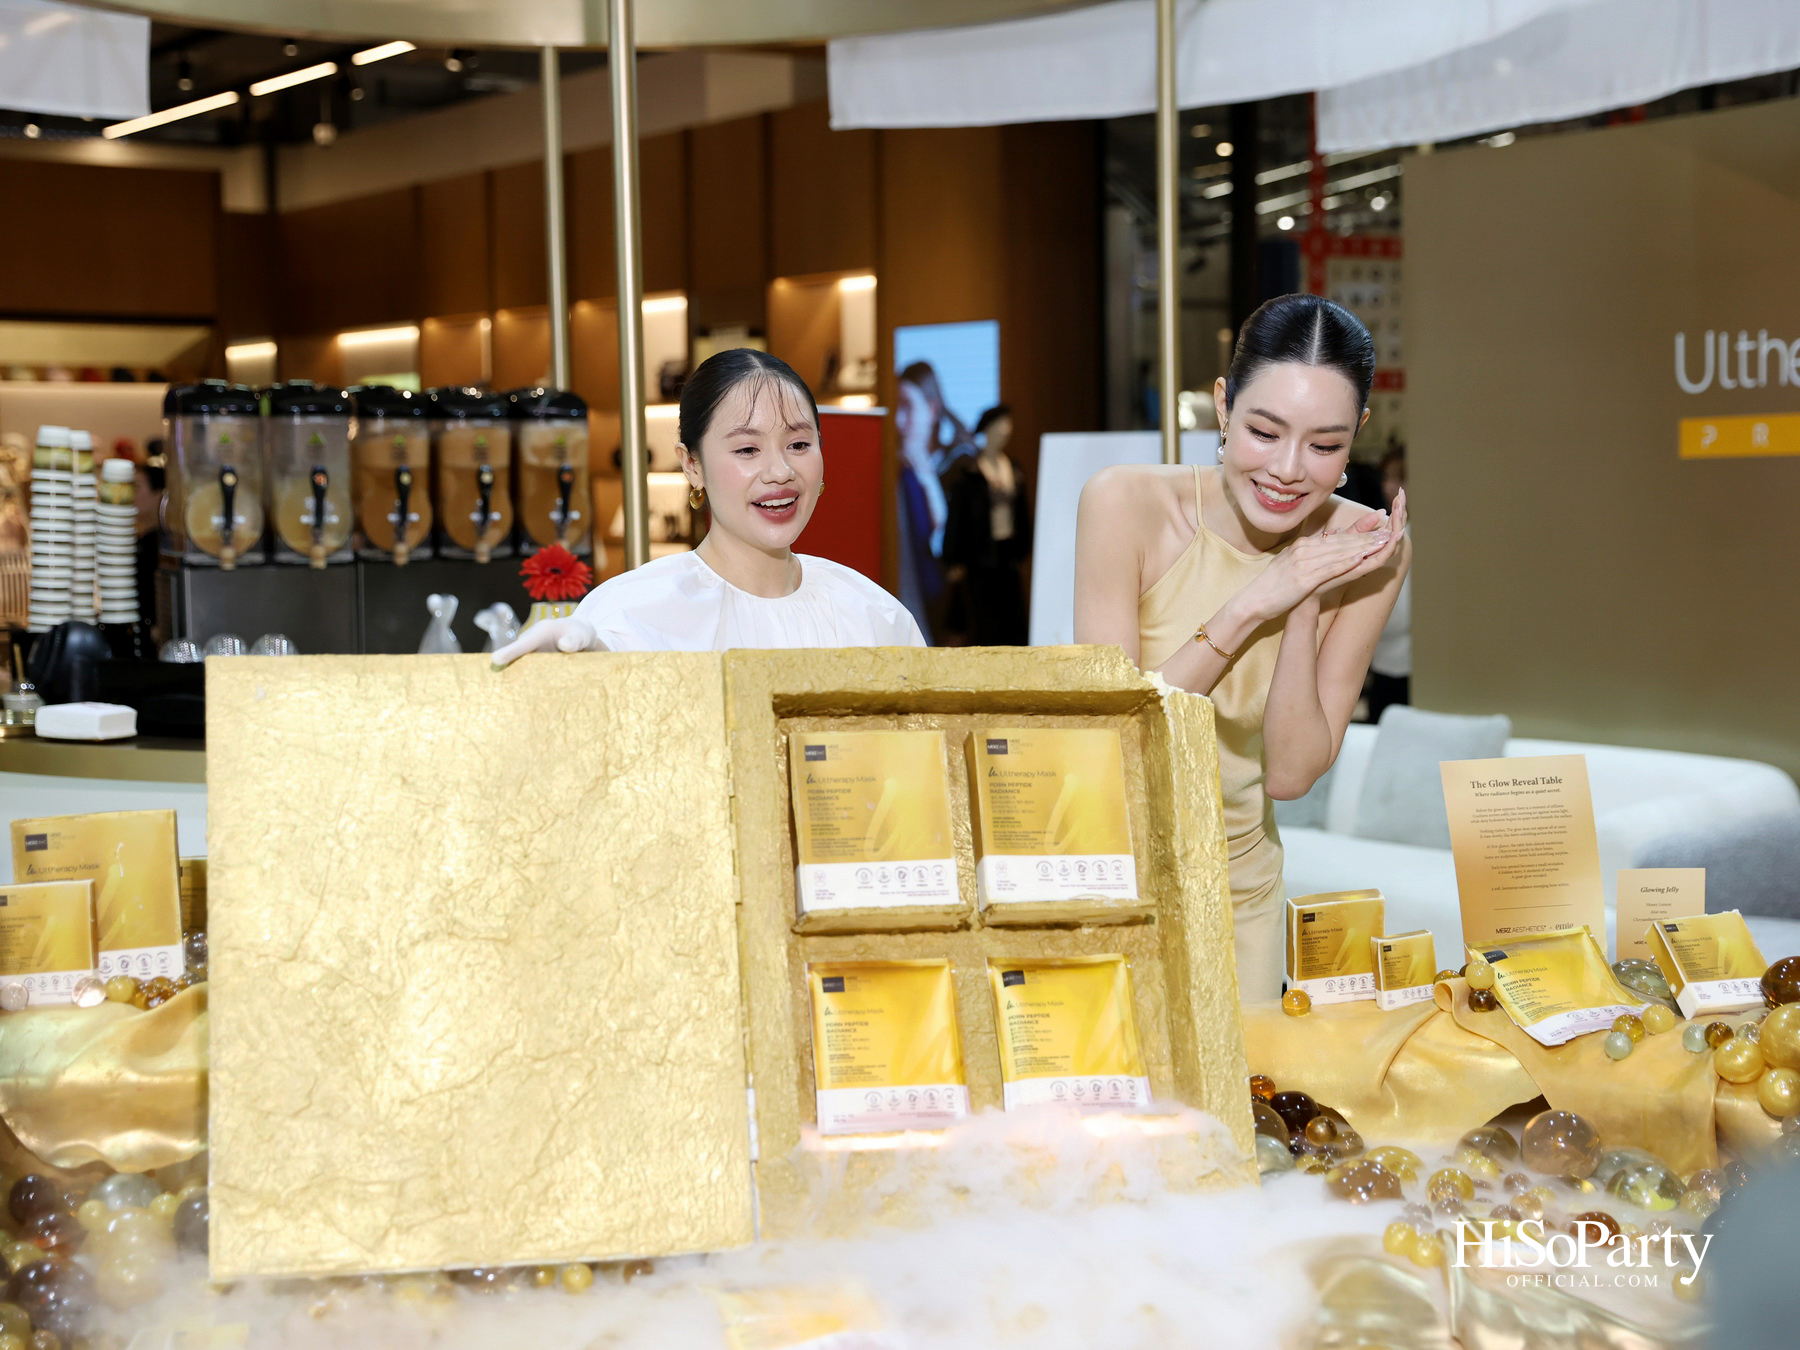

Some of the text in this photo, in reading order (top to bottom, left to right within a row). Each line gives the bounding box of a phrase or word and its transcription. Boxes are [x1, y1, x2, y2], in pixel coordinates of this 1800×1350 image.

[1000, 770, 1036, 778] Ultherapy
[1470, 776, 1562, 789] The Glow Reveal Table
[39, 866, 78, 874] Ultherapy
[1506, 983, 1532, 991] RADIANCE
